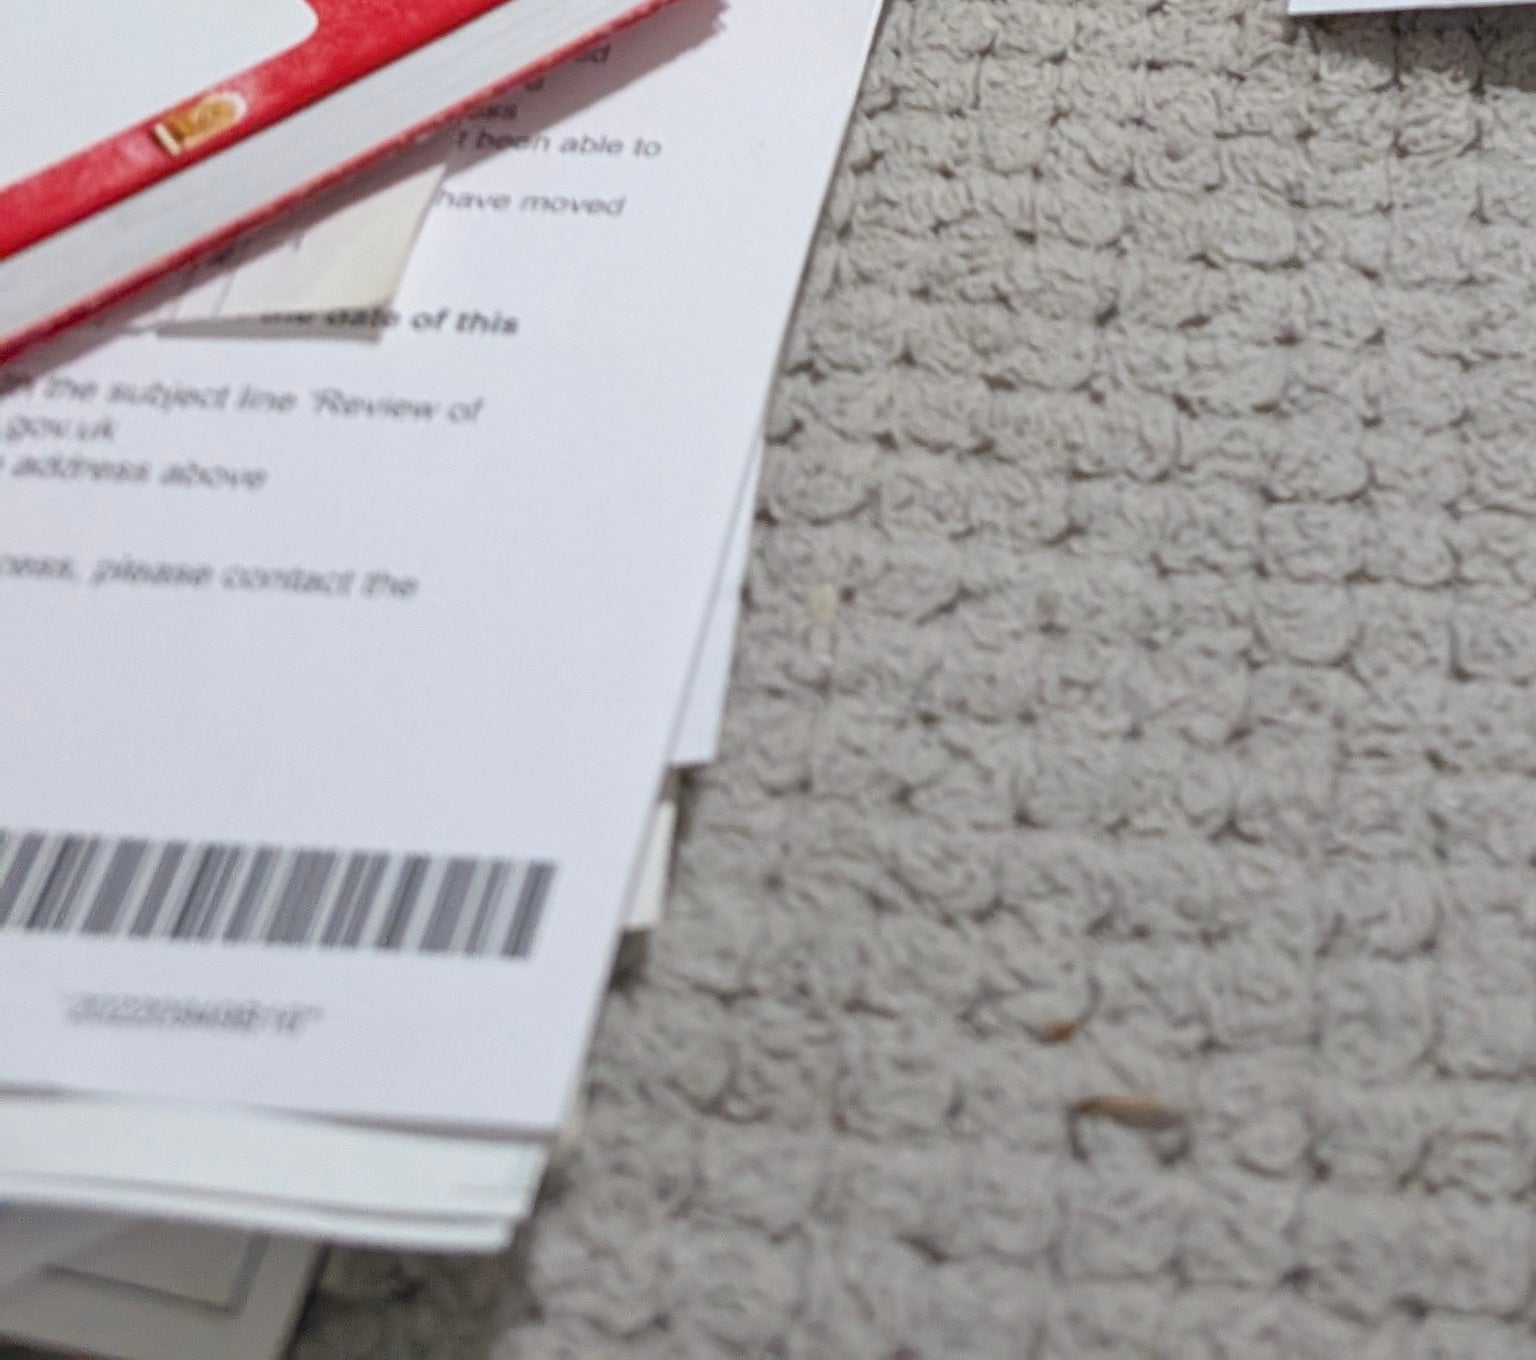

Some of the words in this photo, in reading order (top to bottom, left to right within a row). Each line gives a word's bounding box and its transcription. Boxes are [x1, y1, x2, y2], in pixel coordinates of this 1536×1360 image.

[559, 134, 625, 157] able
[634, 136, 663, 158] to
[520, 192, 628, 217] moved
[410, 306, 446, 332] of
[454, 308, 519, 336] this
